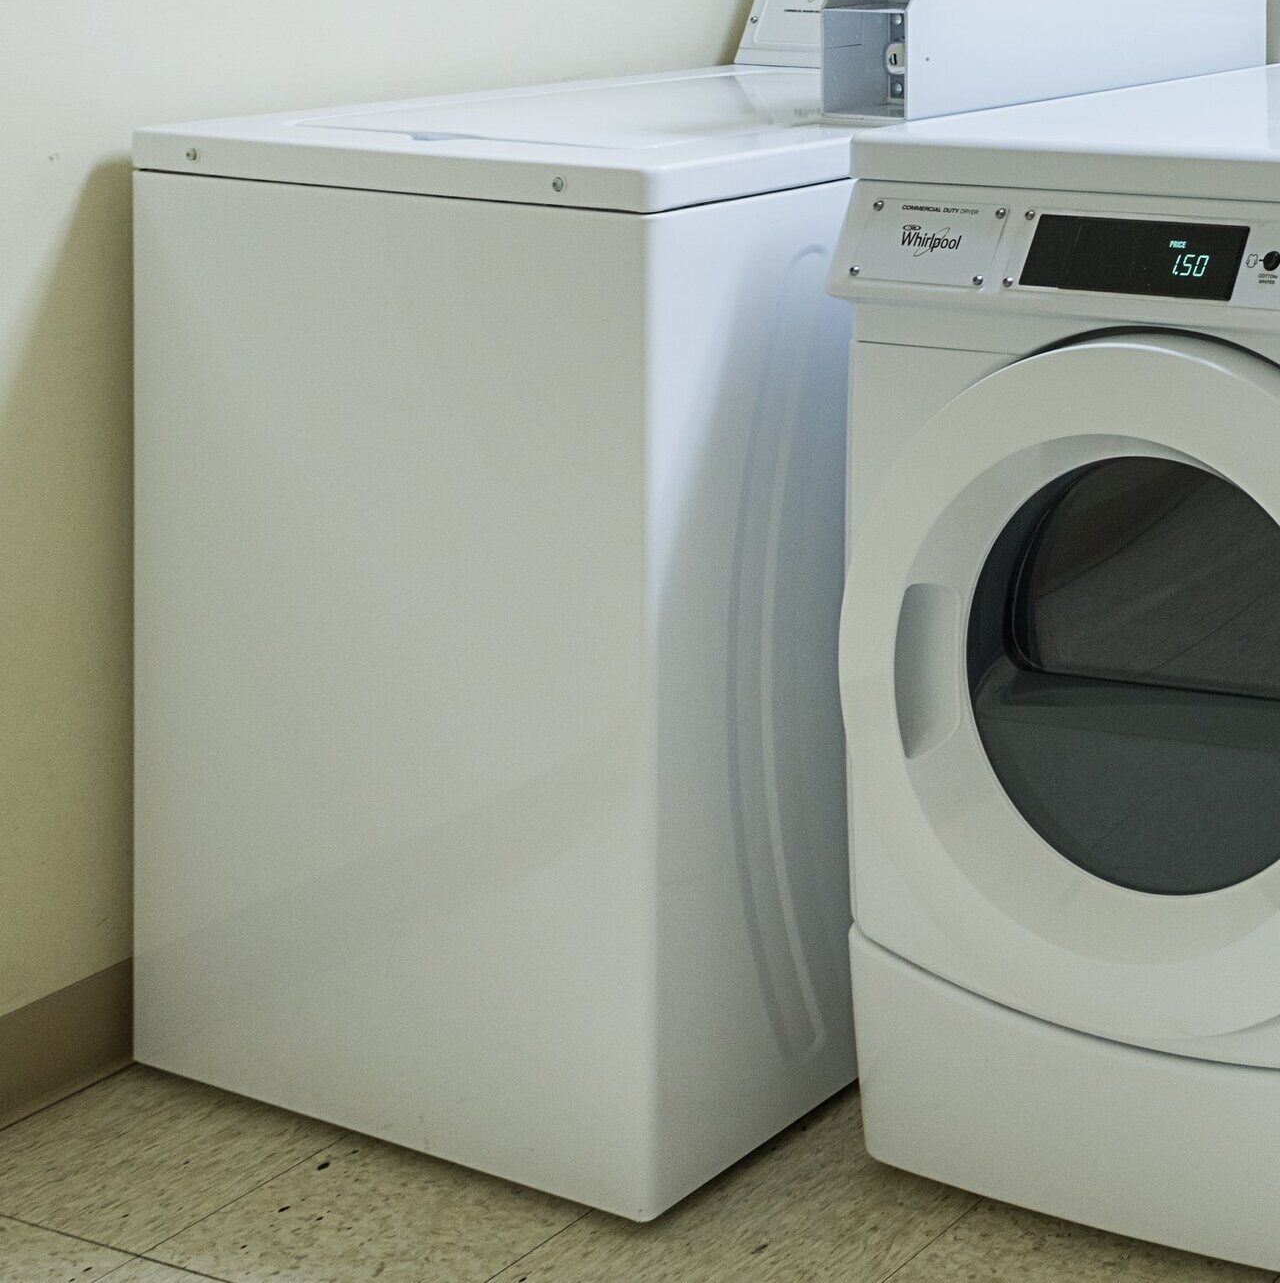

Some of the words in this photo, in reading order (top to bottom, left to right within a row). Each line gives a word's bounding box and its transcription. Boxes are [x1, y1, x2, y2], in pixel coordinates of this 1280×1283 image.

[902, 204, 941, 212] COMMERCIAL
[901, 230, 962, 252] Whirlpool
[1170, 240, 1187, 249] PRICE
[1172, 254, 1210, 278] 1.50
